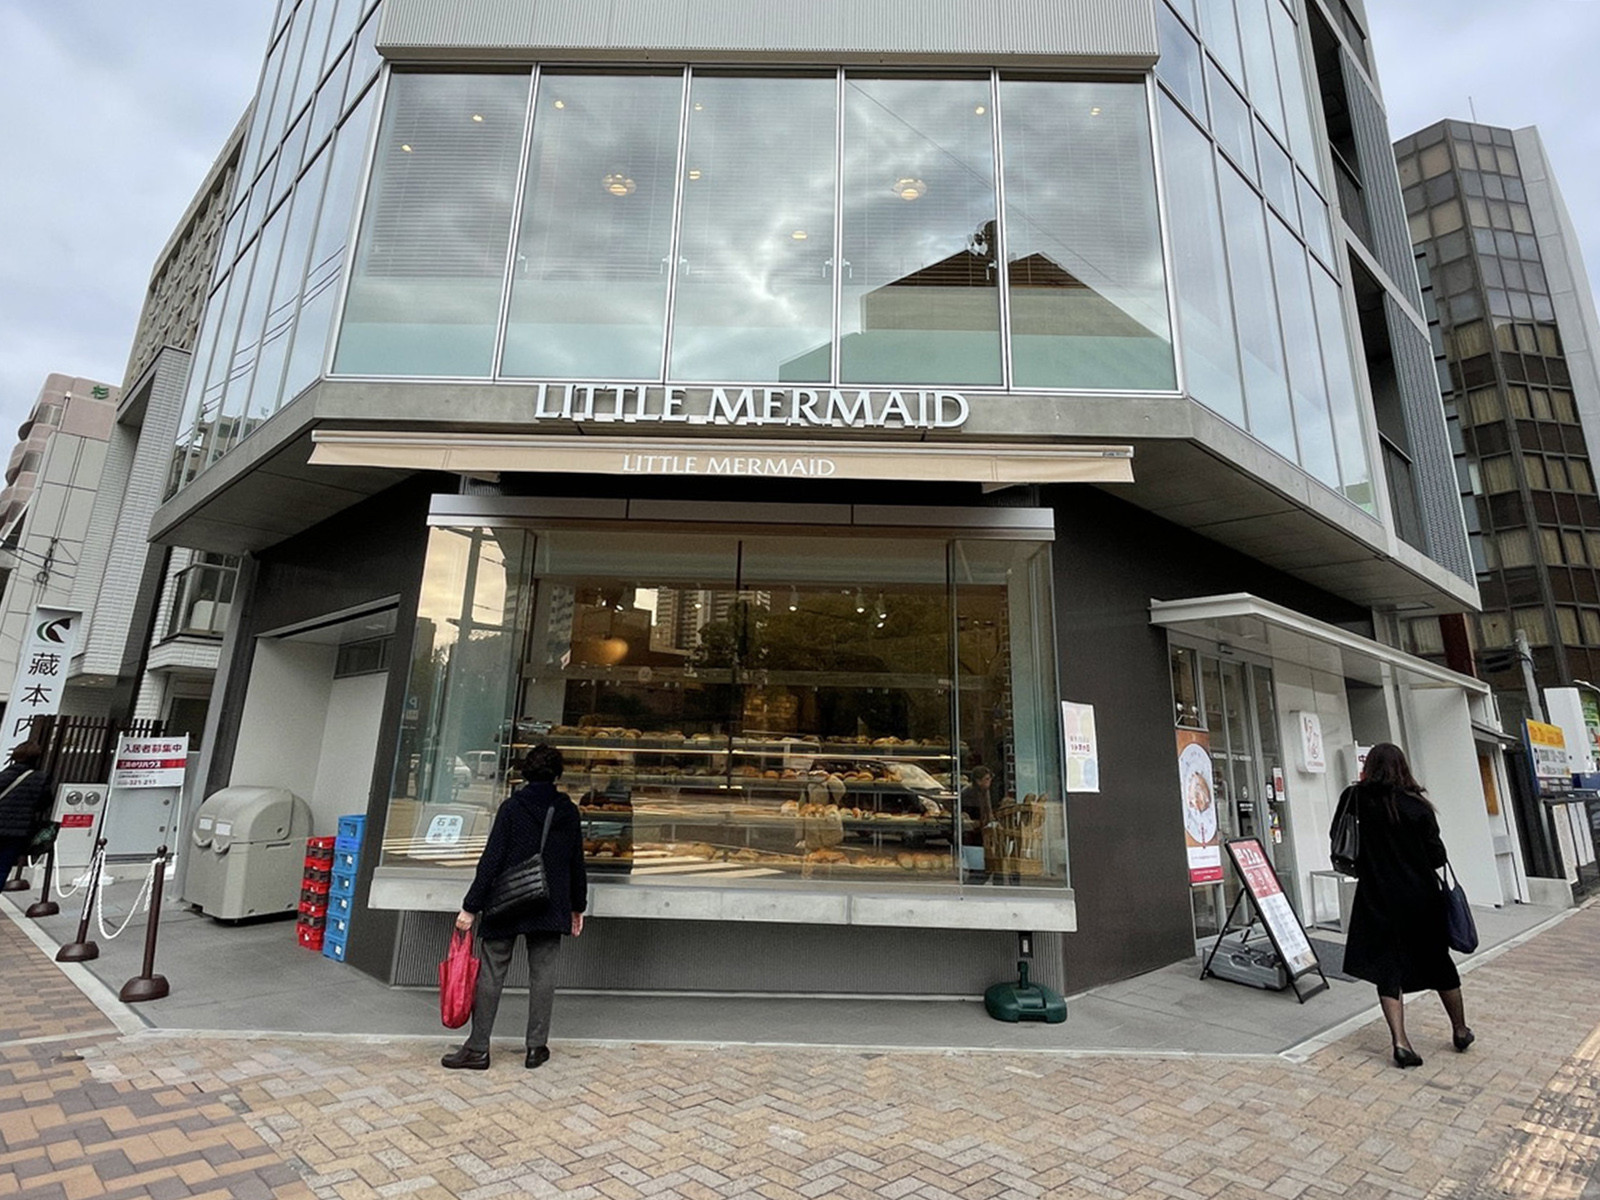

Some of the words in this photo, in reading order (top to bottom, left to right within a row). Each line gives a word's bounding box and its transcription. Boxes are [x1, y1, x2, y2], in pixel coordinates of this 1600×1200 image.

[535, 384, 688, 422] LITTLE
[706, 387, 969, 428] MERMAID
[623, 454, 698, 474] LITTLE
[706, 456, 836, 476] MERMAID
[123, 743, 183, 754] 入居者募集中
